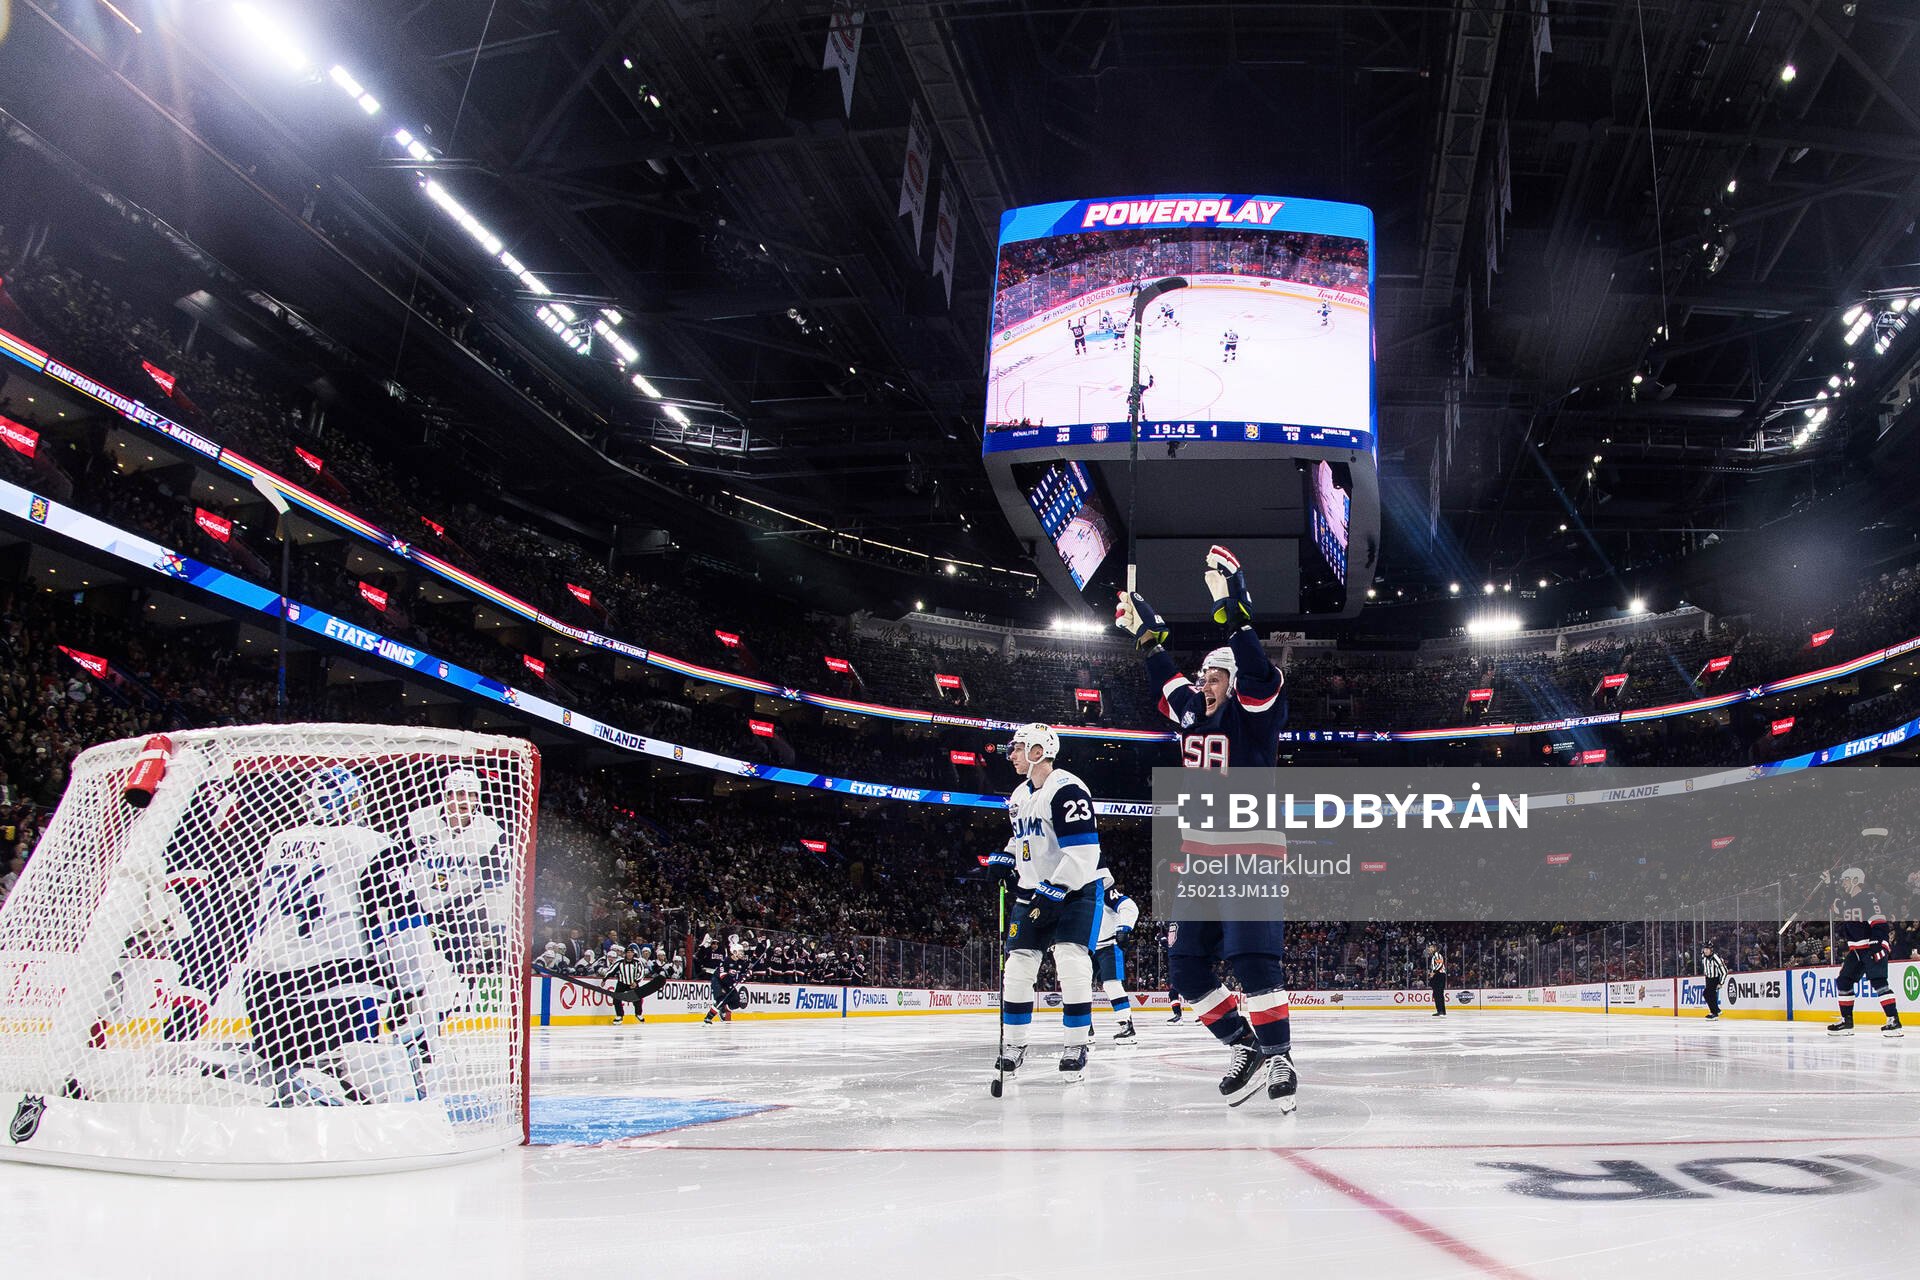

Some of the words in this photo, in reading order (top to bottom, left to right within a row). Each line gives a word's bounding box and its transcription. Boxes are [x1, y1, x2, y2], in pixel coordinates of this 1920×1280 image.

[1082, 201, 1284, 227] POWERPLAY
[46, 359, 137, 414] CONFRONTATION
[134, 405, 158, 426] DES
[156, 419, 170, 433] 4
[169, 425, 219, 457] NATIONS
[1056, 433, 1070, 442] 20
[1154, 424, 1195, 434] 19:45
[1211, 425, 1217, 437] 1
[1286, 432, 1299, 441] 13
[6, 429, 35, 447] ROGERS
[205, 520, 229, 535] ROGERS
[324, 617, 416, 666] ÉTATS-UNIS
[537, 613, 589, 641] CONFRONTATION
[588, 632, 603, 645] DES
[612, 643, 647, 659] NATIONS
[933, 715, 988, 728] CONFRONTATION
[988, 721, 1001, 729] DES
[1516, 722, 1566, 733] CONFRONTATION
[1588, 714, 1620, 724] NATIONS
[593, 724, 647, 750] FINLANDE
[1845, 728, 1906, 757] ÉTATS-UNIS
[1184, 735, 1228, 777] SA
[849, 781, 920, 800] ÉTATS-UNIS
[1601, 785, 1659, 801] FINLANDE
[1063, 799, 1091, 823] 23
[1102, 804, 1161, 816] FINLANDE
[750, 992, 771, 1004] NHL
[778, 993, 790, 1004] 25
[1738, 983, 1759, 998] NHL
[1766, 981, 1781, 998] 25
[796, 988, 838, 1009] FASTENAL
[862, 993, 888, 1004] FANDUEL
[929, 991, 953, 1008] TYLENOL
[962, 994, 982, 1005] ROGERS
